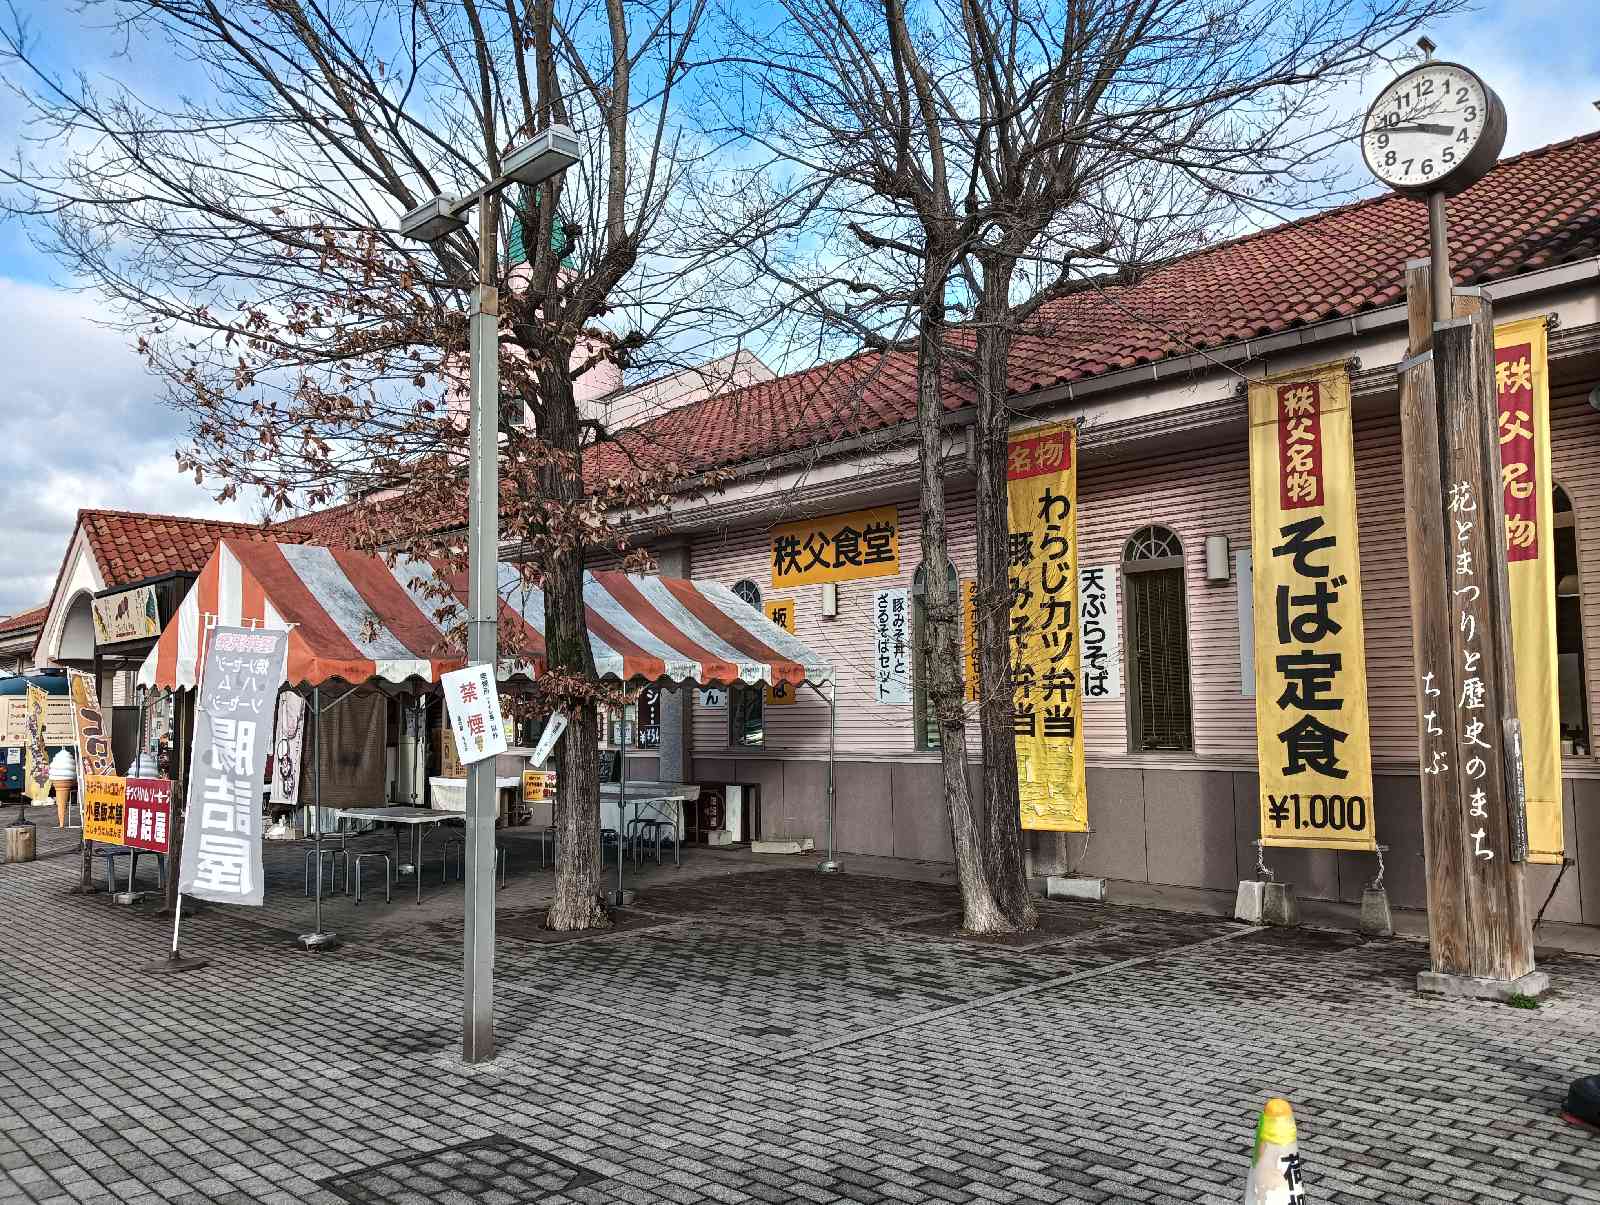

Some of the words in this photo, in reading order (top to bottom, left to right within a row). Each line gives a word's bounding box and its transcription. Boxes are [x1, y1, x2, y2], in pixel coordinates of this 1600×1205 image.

[1413, 79, 1434, 97] 12
[1441, 79, 1450, 95] 1
[1456, 87, 1469, 105] 2
[1393, 91, 1410, 110] 11
[1379, 111, 1400, 127] 10
[1463, 105, 1477, 123] 3
[1377, 133, 1390, 150] 9
[1456, 127, 1469, 144] 4
[1384, 150, 1397, 167] 8
[1441, 146, 1455, 164] 5
[1401, 158, 1415, 176] 7
[1420, 158, 1434, 175] 6
[1283, 386, 1318, 503] 秩父名物
[1009, 441, 1065, 474] 名物
[1495, 357, 1537, 556] 秩父名物
[773, 521, 895, 576] 秩父食堂
[1038, 488, 1075, 738] わらじカツ弁当
[893, 598, 906, 674] 豚みそ丼と
[1080, 569, 1108, 697] 天ぷらそば
[1272, 516, 1349, 779] そば定食
[1447, 483, 1495, 861] 花とまつりと歴史のまち
[460, 681, 485, 736] 禁煙
[1422, 672, 1449, 776] ちちぶ
